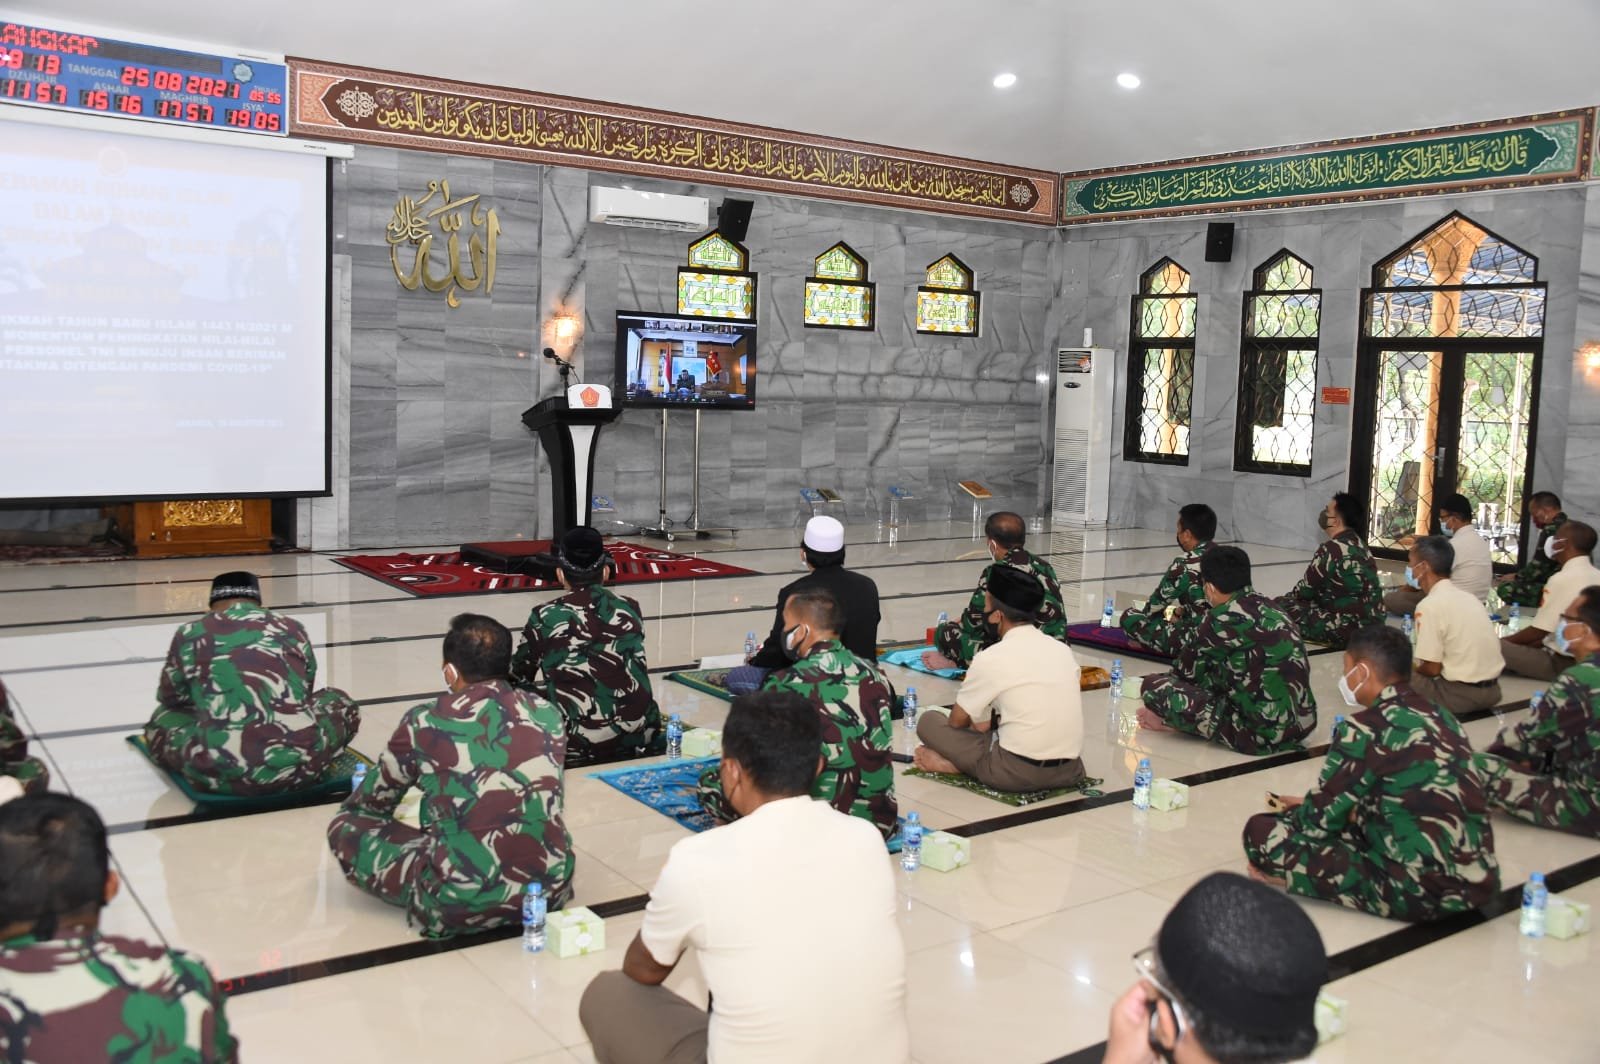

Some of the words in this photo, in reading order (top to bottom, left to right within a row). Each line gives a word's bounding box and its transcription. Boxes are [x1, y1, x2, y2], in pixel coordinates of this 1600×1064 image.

[37, 54, 61, 75] 13
[68, 63, 118, 79] TANGGAL
[121, 66, 150, 87] 25
[153, 71, 183, 92] 08
[186, 75, 240, 99] 2021
[93, 82, 130, 95] ASHAR
[36, 82, 68, 103] 57
[160, 91, 209, 105] MAGHRIB
[87, 90, 109, 110] 15
[120, 95, 143, 114] 16
[160, 100, 183, 119] 17
[185, 103, 214, 122] 57
[229, 109, 252, 128] 19
[253, 111, 281, 131] 05
[56, 315, 108, 327] TAHUN
[111, 317, 151, 329] BARU
[154, 319, 197, 330] ISLAM
[3, 330, 95, 342] MOMENTUM
[97, 332, 198, 344] PENINGKATAN
[5, 344, 86, 357] PERSONEL
[88, 346, 115, 358] TNI
[118, 347, 177, 359] MENUJU
[63, 361, 139, 372] DITENGAH
